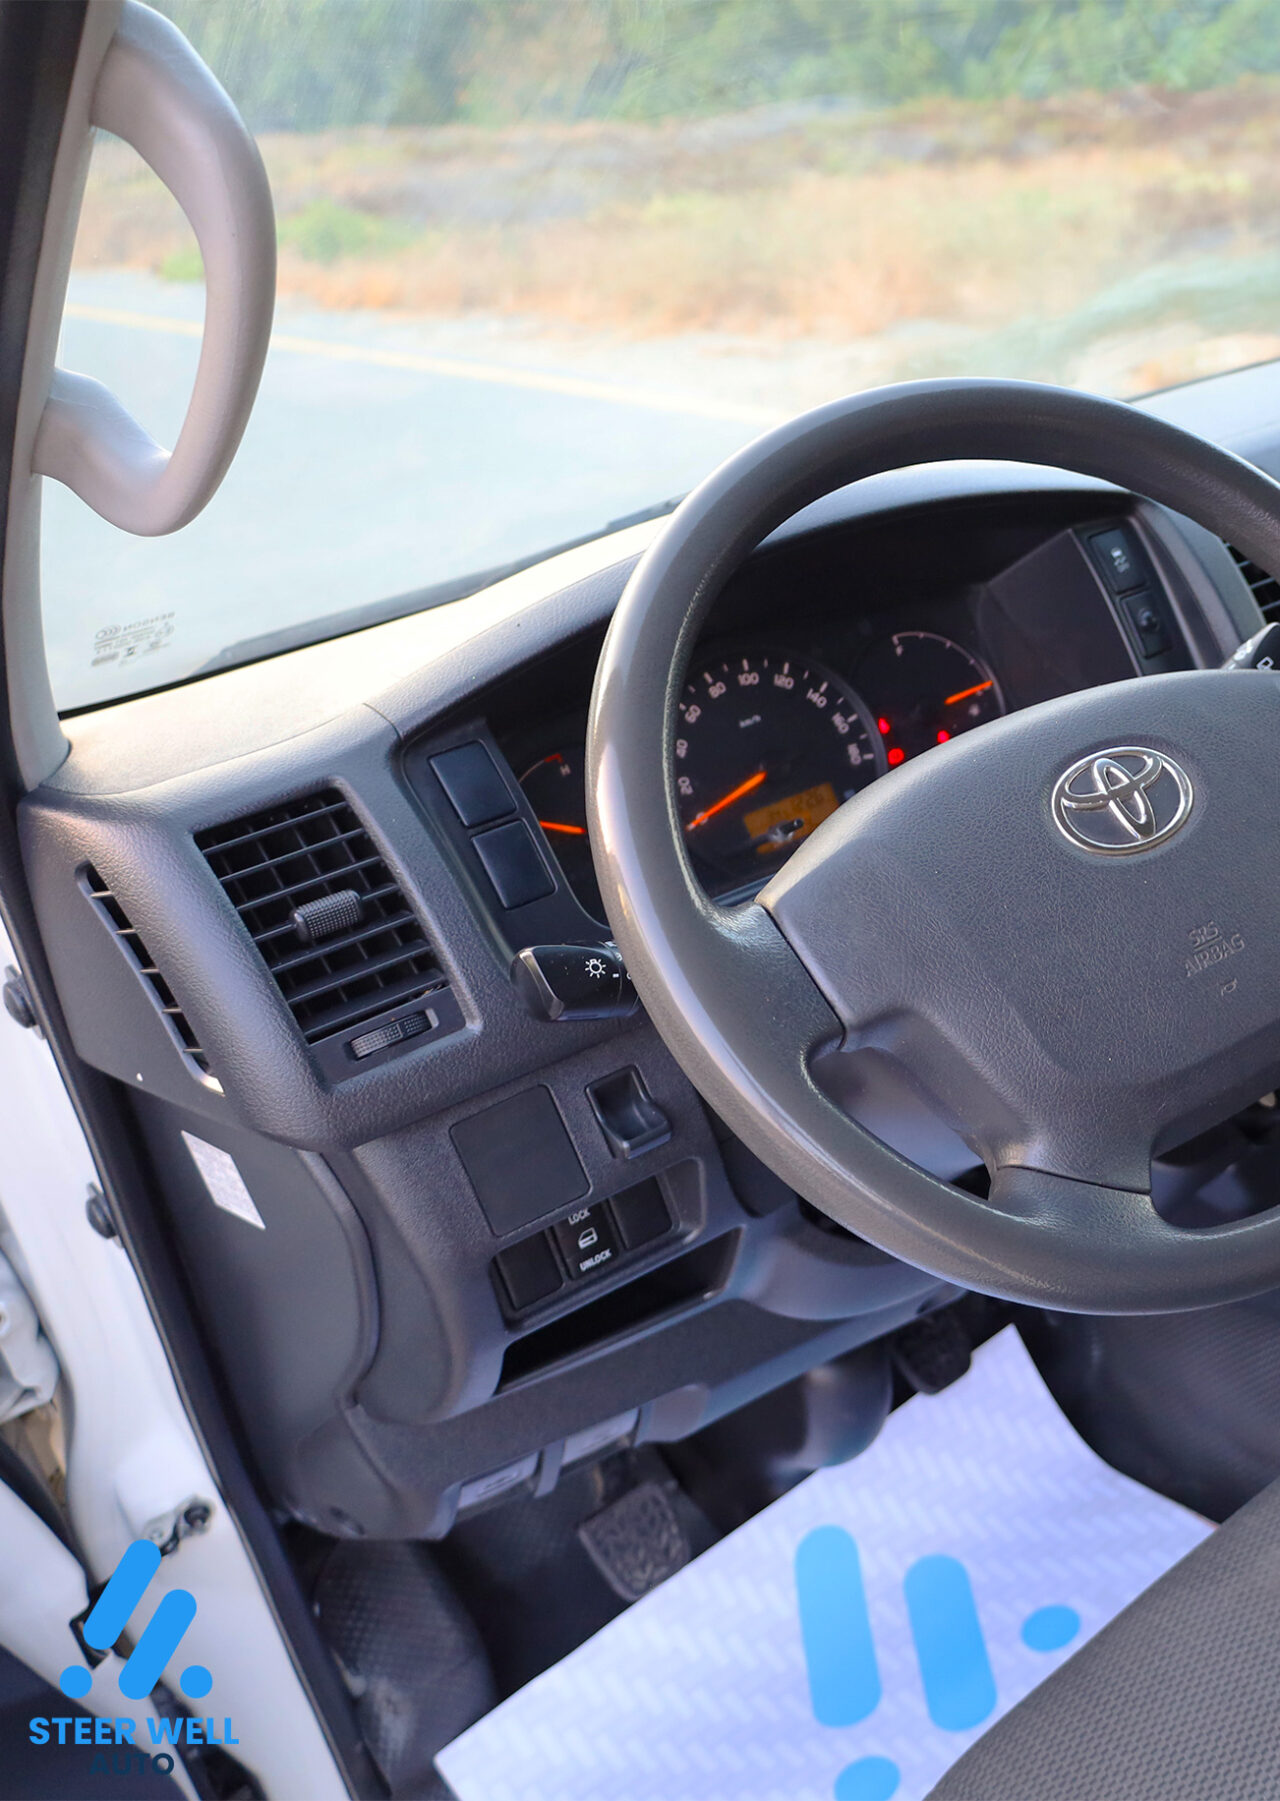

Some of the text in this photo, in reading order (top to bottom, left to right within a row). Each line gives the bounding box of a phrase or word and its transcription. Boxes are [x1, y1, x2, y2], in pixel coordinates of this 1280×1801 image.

[738, 672, 760, 686] 100
[773, 673, 794, 690] 120
[708, 681, 727, 699] 80
[806, 688, 828, 709] 140
[1184, 933, 1245, 977] AIRBAG
[568, 1208, 590, 1225] LOCK
[580, 1249, 611, 1271] UNLOCK
